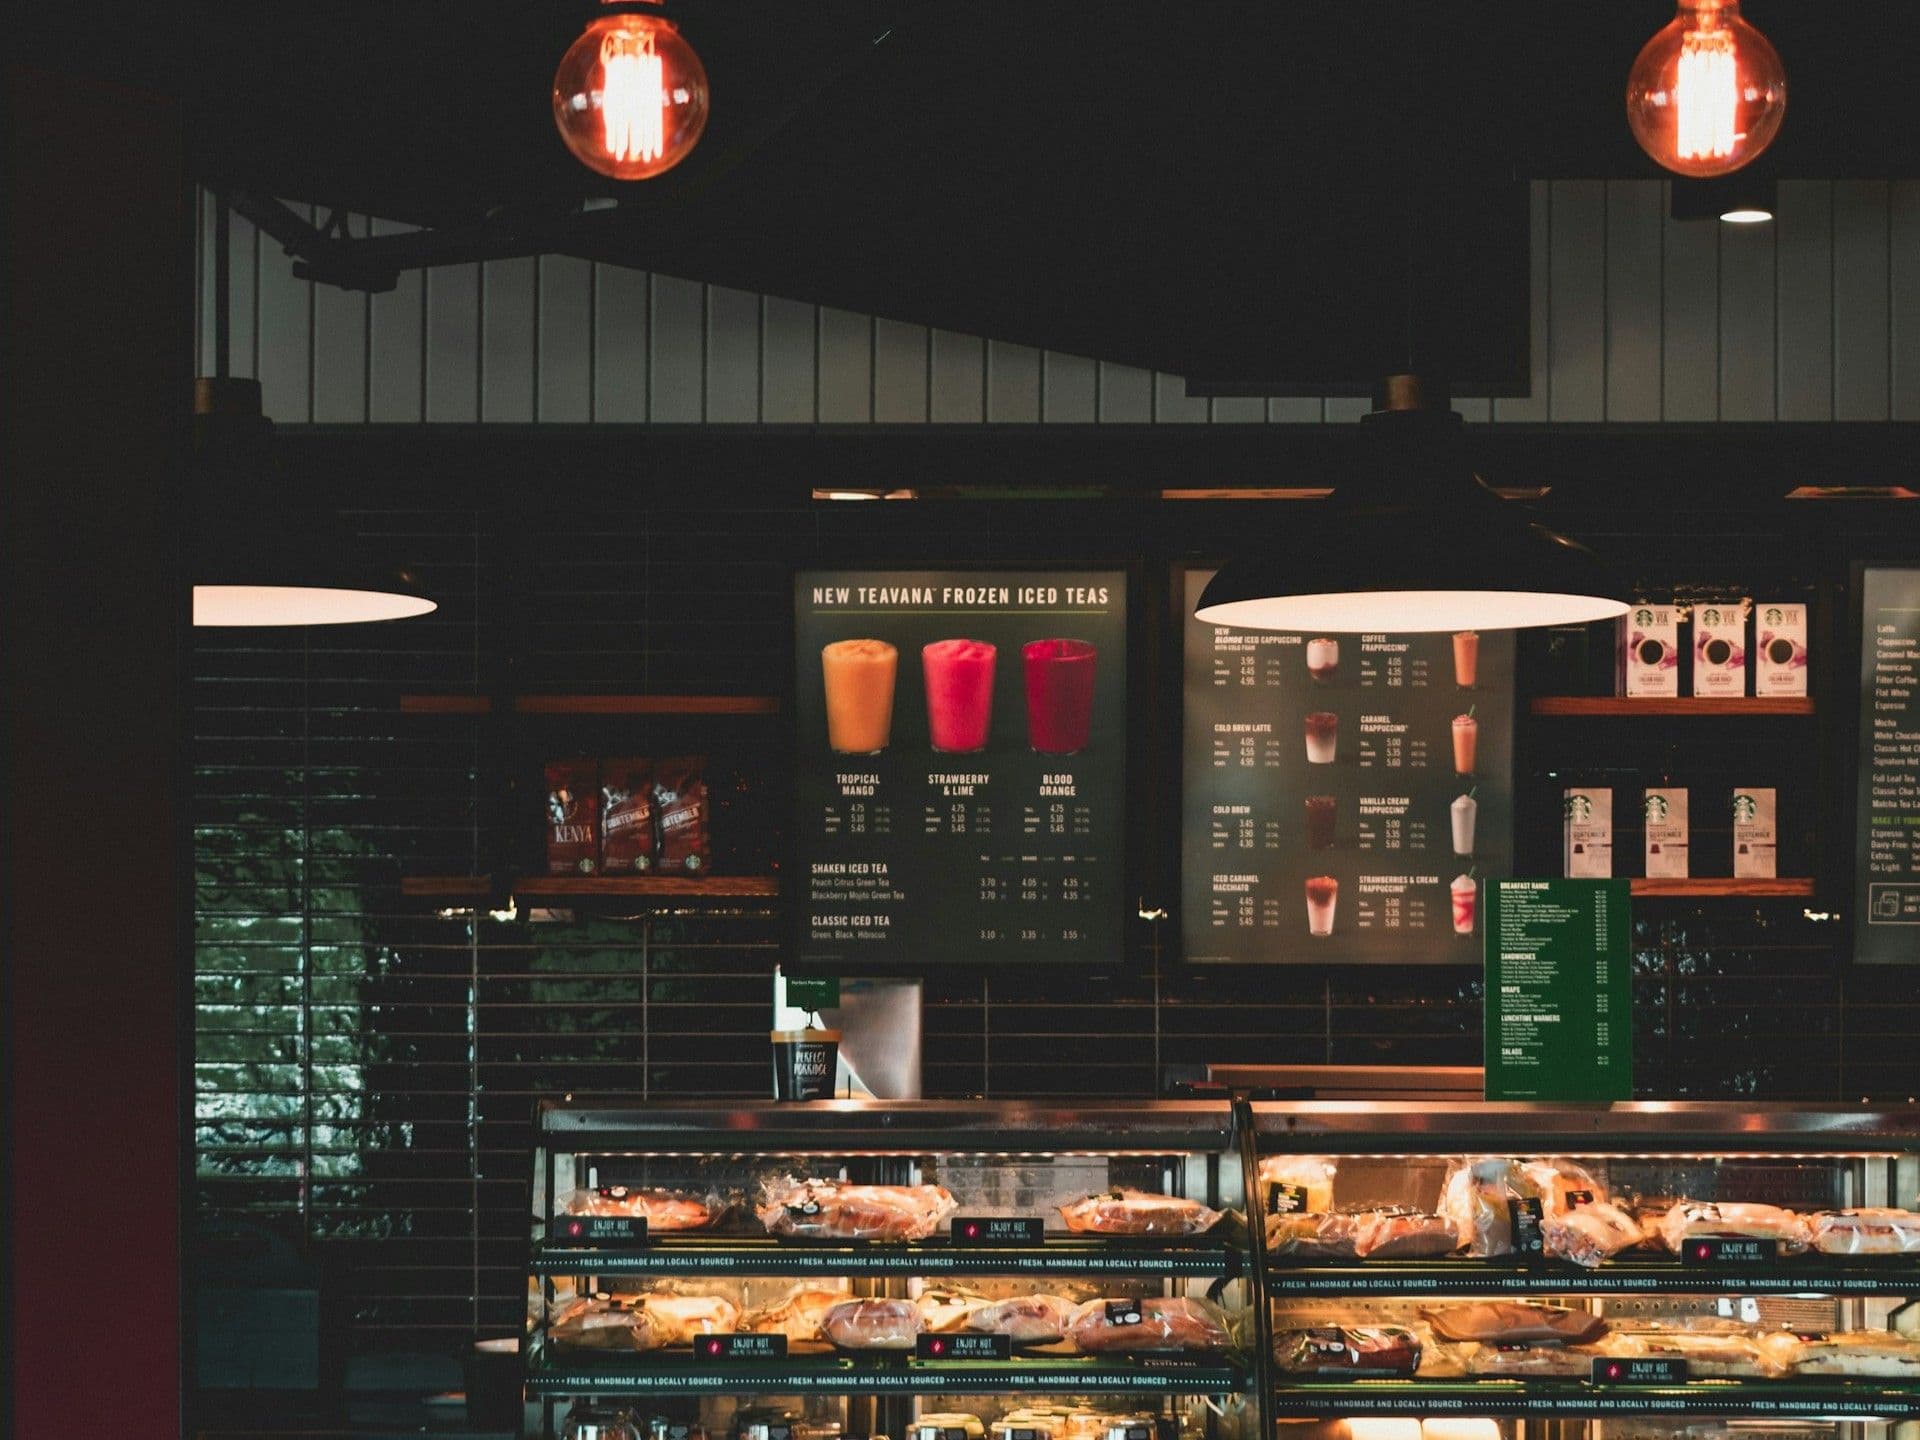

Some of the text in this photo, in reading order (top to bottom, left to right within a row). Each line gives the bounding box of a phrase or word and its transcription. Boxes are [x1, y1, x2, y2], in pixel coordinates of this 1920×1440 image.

[814, 588, 849, 603] NEW
[944, 588, 1008, 603] FROZEN
[1018, 588, 1057, 604] ICED
[1066, 588, 1108, 604] TEAS
[1215, 724, 1271, 732] COLD BREW LATTE
[837, 774, 880, 784] TROPICAL
[928, 775, 989, 784] STRAWBERRY
[1043, 775, 1072, 784] BLOOD
[842, 786, 874, 795] MANGO
[944, 786, 974, 795] & LIME
[1040, 786, 1075, 795] ORANGE
[1231, 806, 1250, 814] BREW
[556, 826, 592, 842] KENYA
[812, 864, 887, 873] SHAKEN ICED TEA
[812, 916, 889, 926] CLASSIC ICED TEA
[796, 1051, 826, 1062] PERFECT
[594, 1221, 628, 1230] ENJOY HOT
[991, 1222, 1025, 1232] ENJOY HOT
[1722, 1243, 1757, 1253] ENJOY HOT
[734, 1338, 768, 1348] ENJOY HOT
[956, 1339, 991, 1348] ENJOY HOT
[1632, 1363, 1667, 1373] ENJOY HOT
